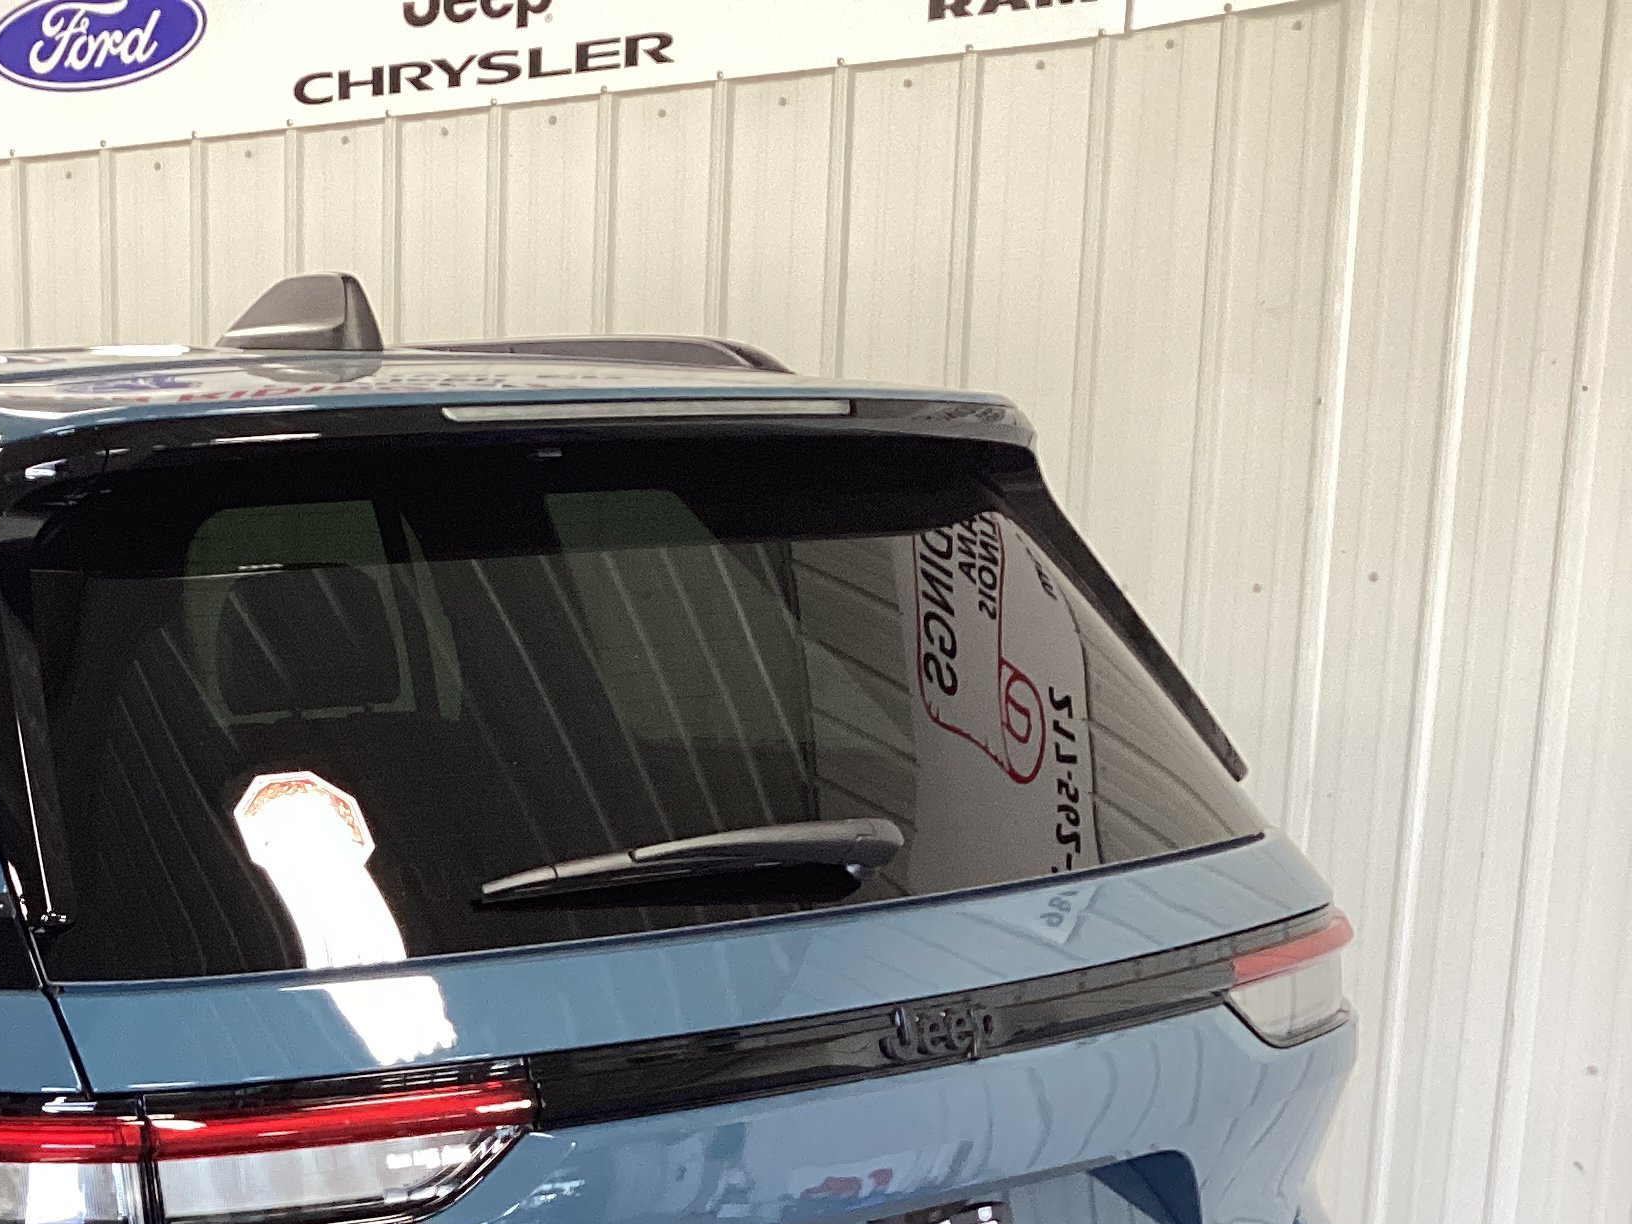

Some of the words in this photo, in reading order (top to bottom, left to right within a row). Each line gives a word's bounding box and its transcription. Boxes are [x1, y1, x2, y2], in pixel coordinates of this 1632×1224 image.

[29, 0, 160, 75] Ford
[293, 32, 675, 106] CHRYSLER
[879, 1004, 995, 1062] Jeep
